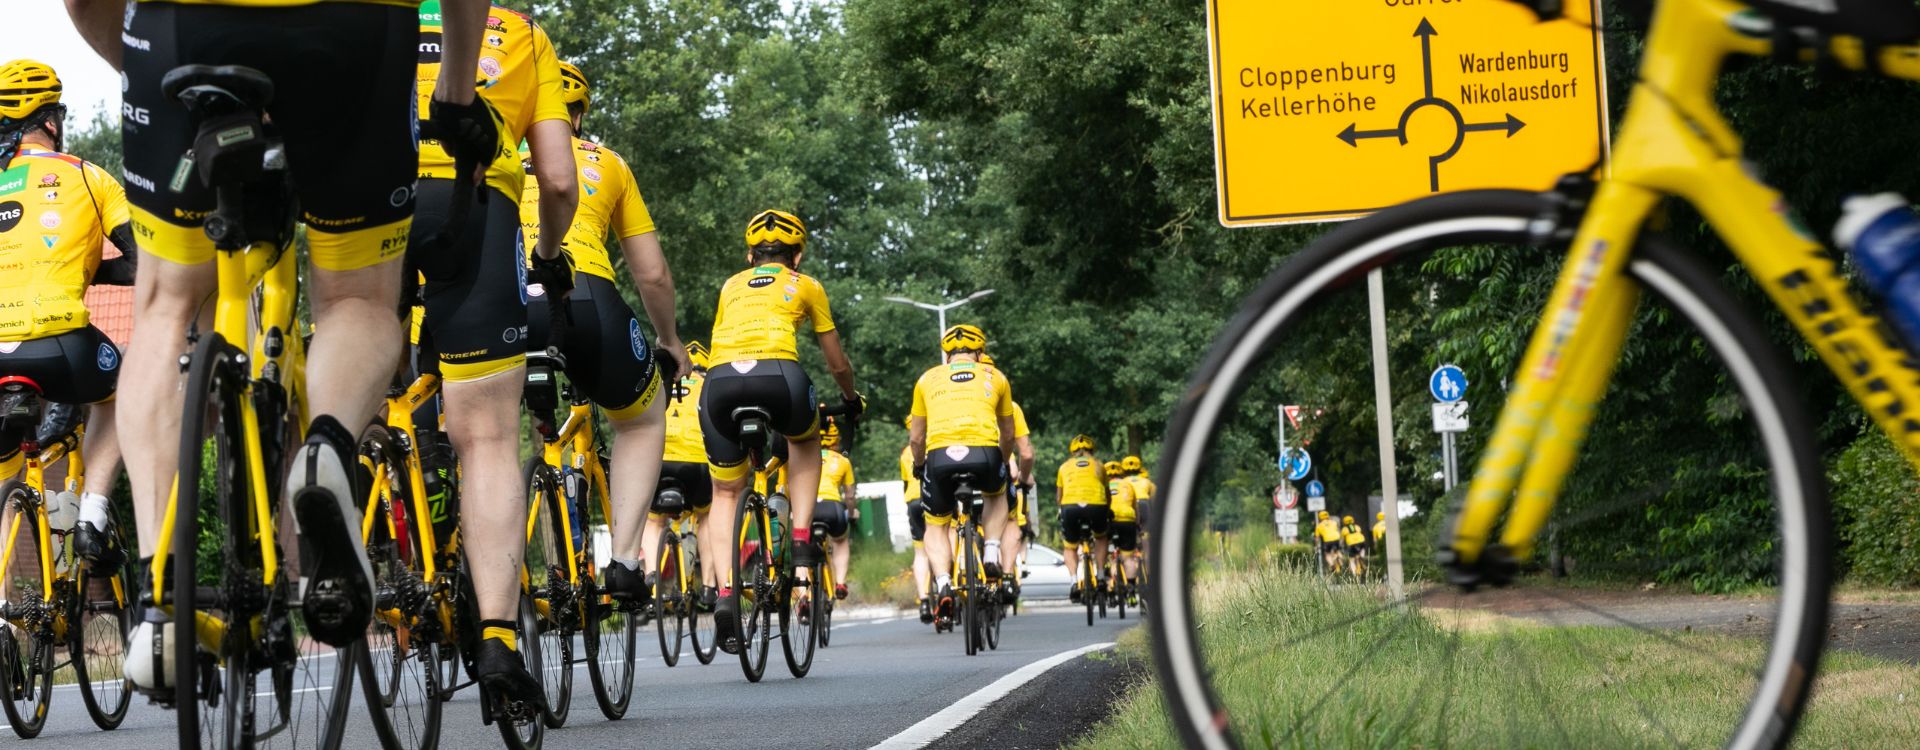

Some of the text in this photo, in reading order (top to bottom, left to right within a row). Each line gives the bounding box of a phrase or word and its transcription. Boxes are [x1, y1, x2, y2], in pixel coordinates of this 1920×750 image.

[1460, 50, 1569, 73] Wardenburg
[1240, 62, 1395, 90] Cloppenburg
[1461, 77, 1577, 104] Nikolausdorf
[1241, 92, 1376, 118] Kellerhöhe
